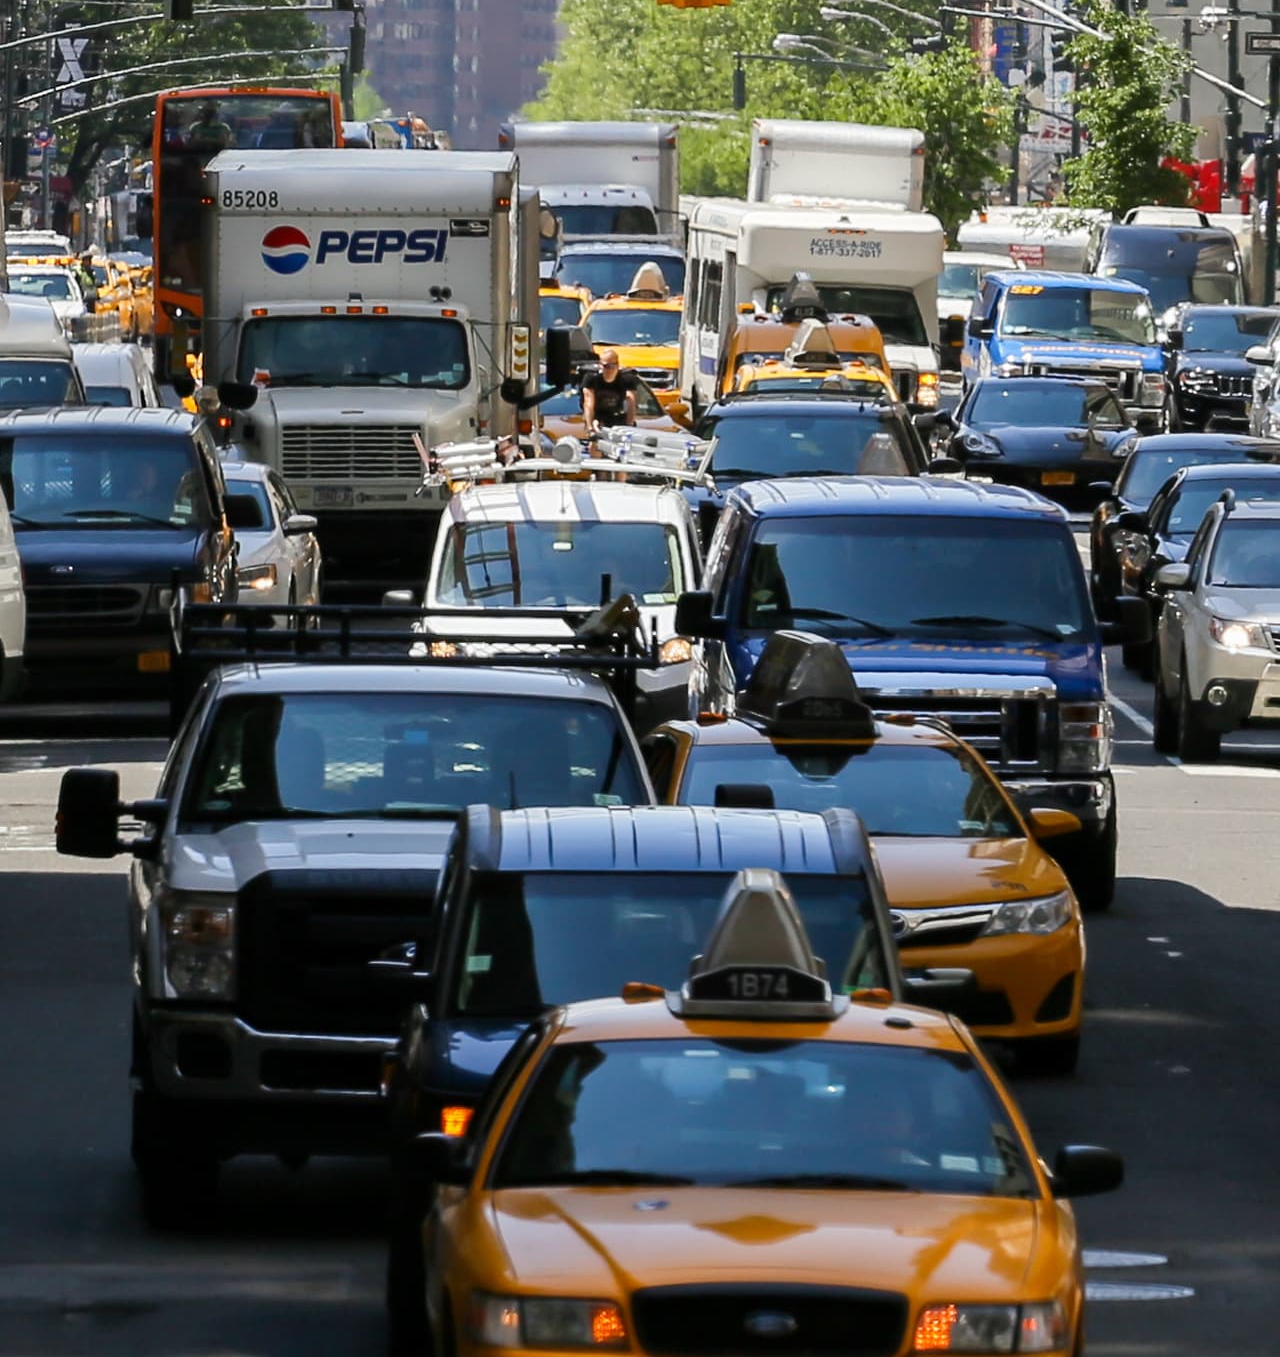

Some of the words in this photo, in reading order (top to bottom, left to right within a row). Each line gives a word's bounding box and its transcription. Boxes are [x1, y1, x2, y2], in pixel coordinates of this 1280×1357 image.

[222, 190, 279, 208] 85208
[315, 229, 449, 265] PEPSI
[809, 238, 883, 249] ACCESS-A-RIDE
[727, 972, 789, 997] 1B74
